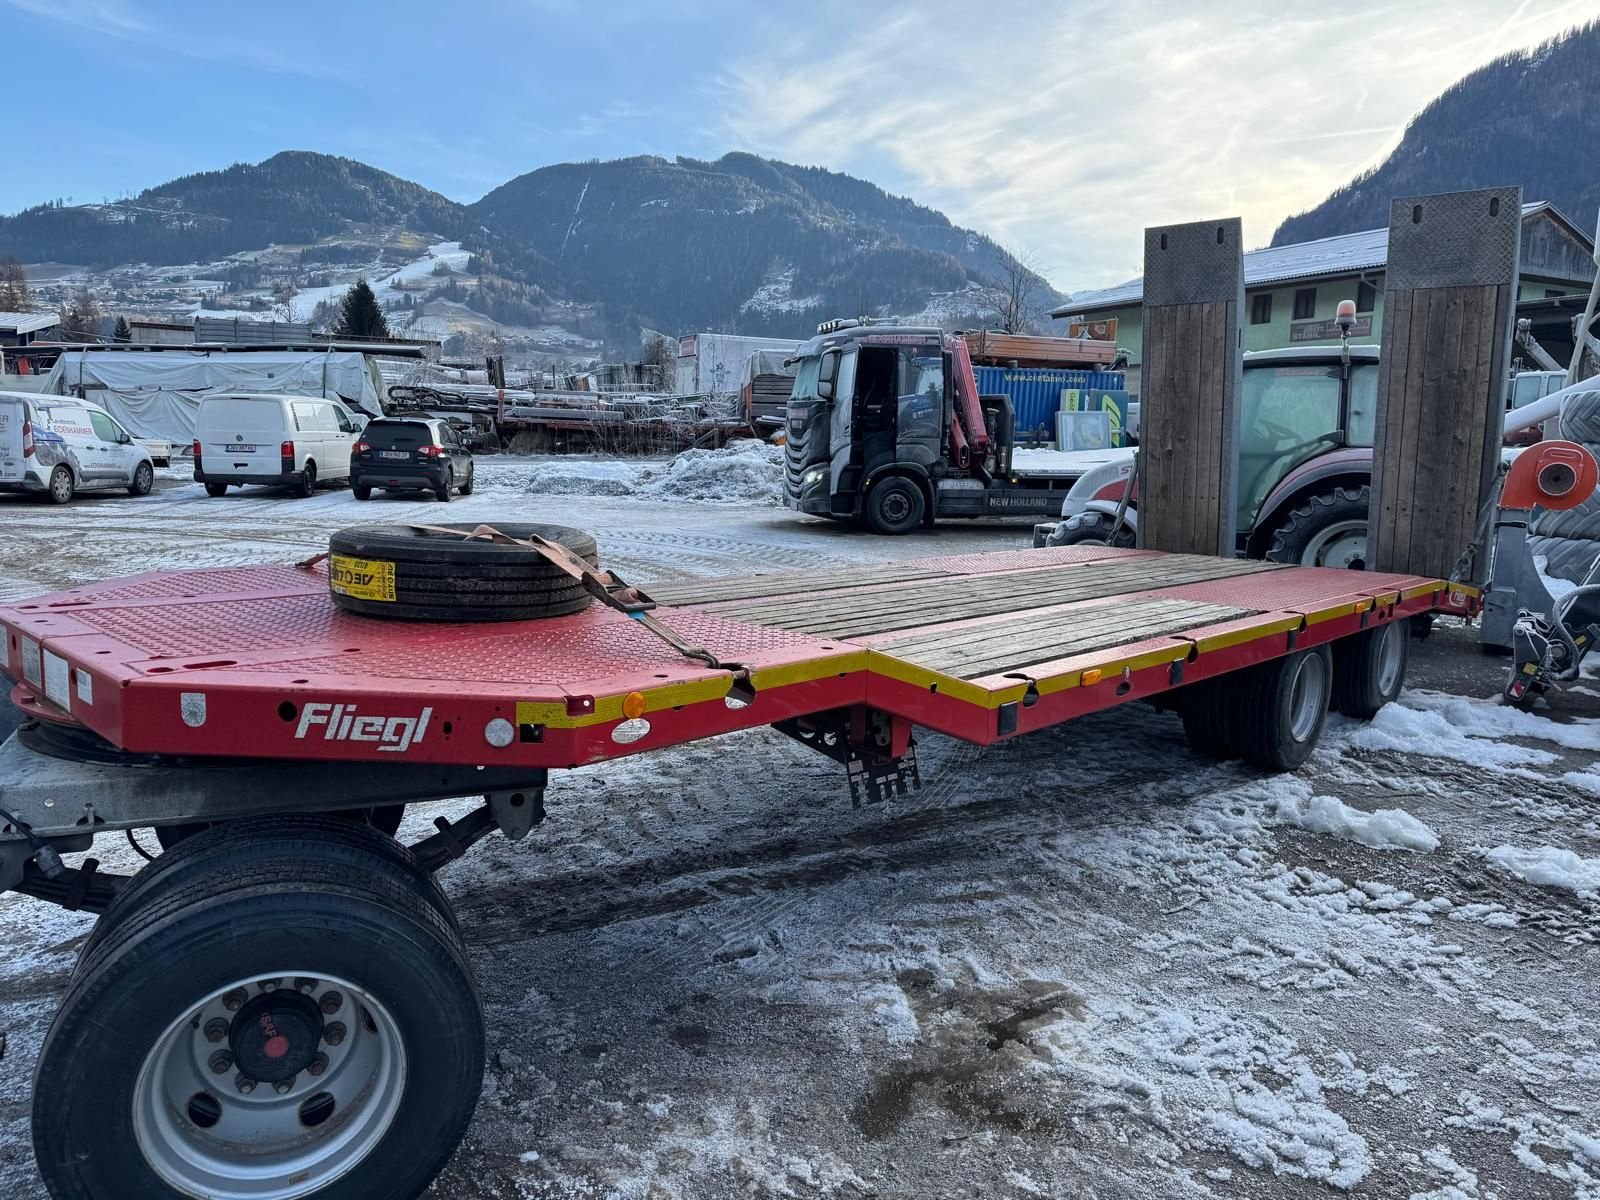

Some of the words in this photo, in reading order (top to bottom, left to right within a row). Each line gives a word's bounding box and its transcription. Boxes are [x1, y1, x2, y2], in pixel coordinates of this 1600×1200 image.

[990, 497, 1009, 507] NEW
[1010, 497, 1048, 507] HOLLAND
[294, 702, 434, 752] Fliegl
